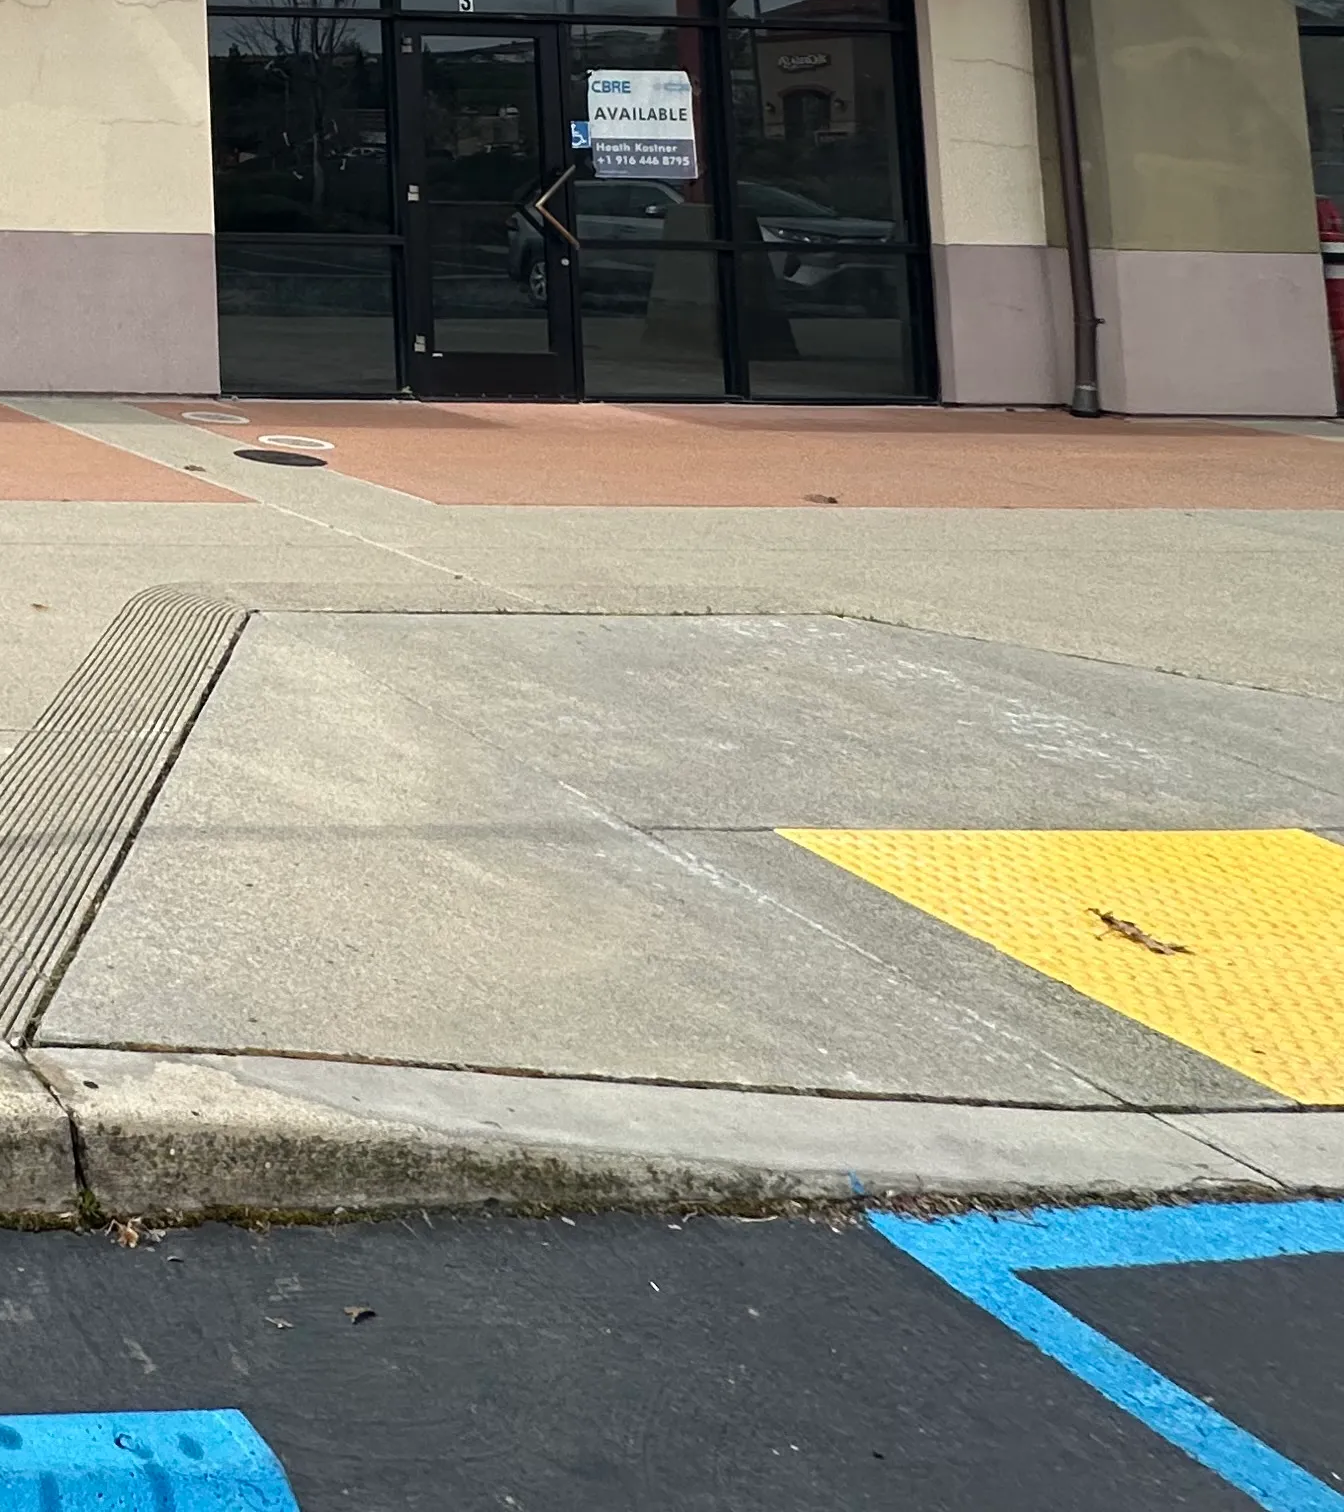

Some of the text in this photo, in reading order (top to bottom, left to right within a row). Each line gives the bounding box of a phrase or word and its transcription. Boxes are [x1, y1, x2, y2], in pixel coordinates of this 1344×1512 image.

[592, 80, 632, 94] CBRE
[594, 107, 688, 121] AVAILABLE
[596, 142, 678, 153] Heath Kastner
[597, 155, 690, 167] +1 916 446 8795
